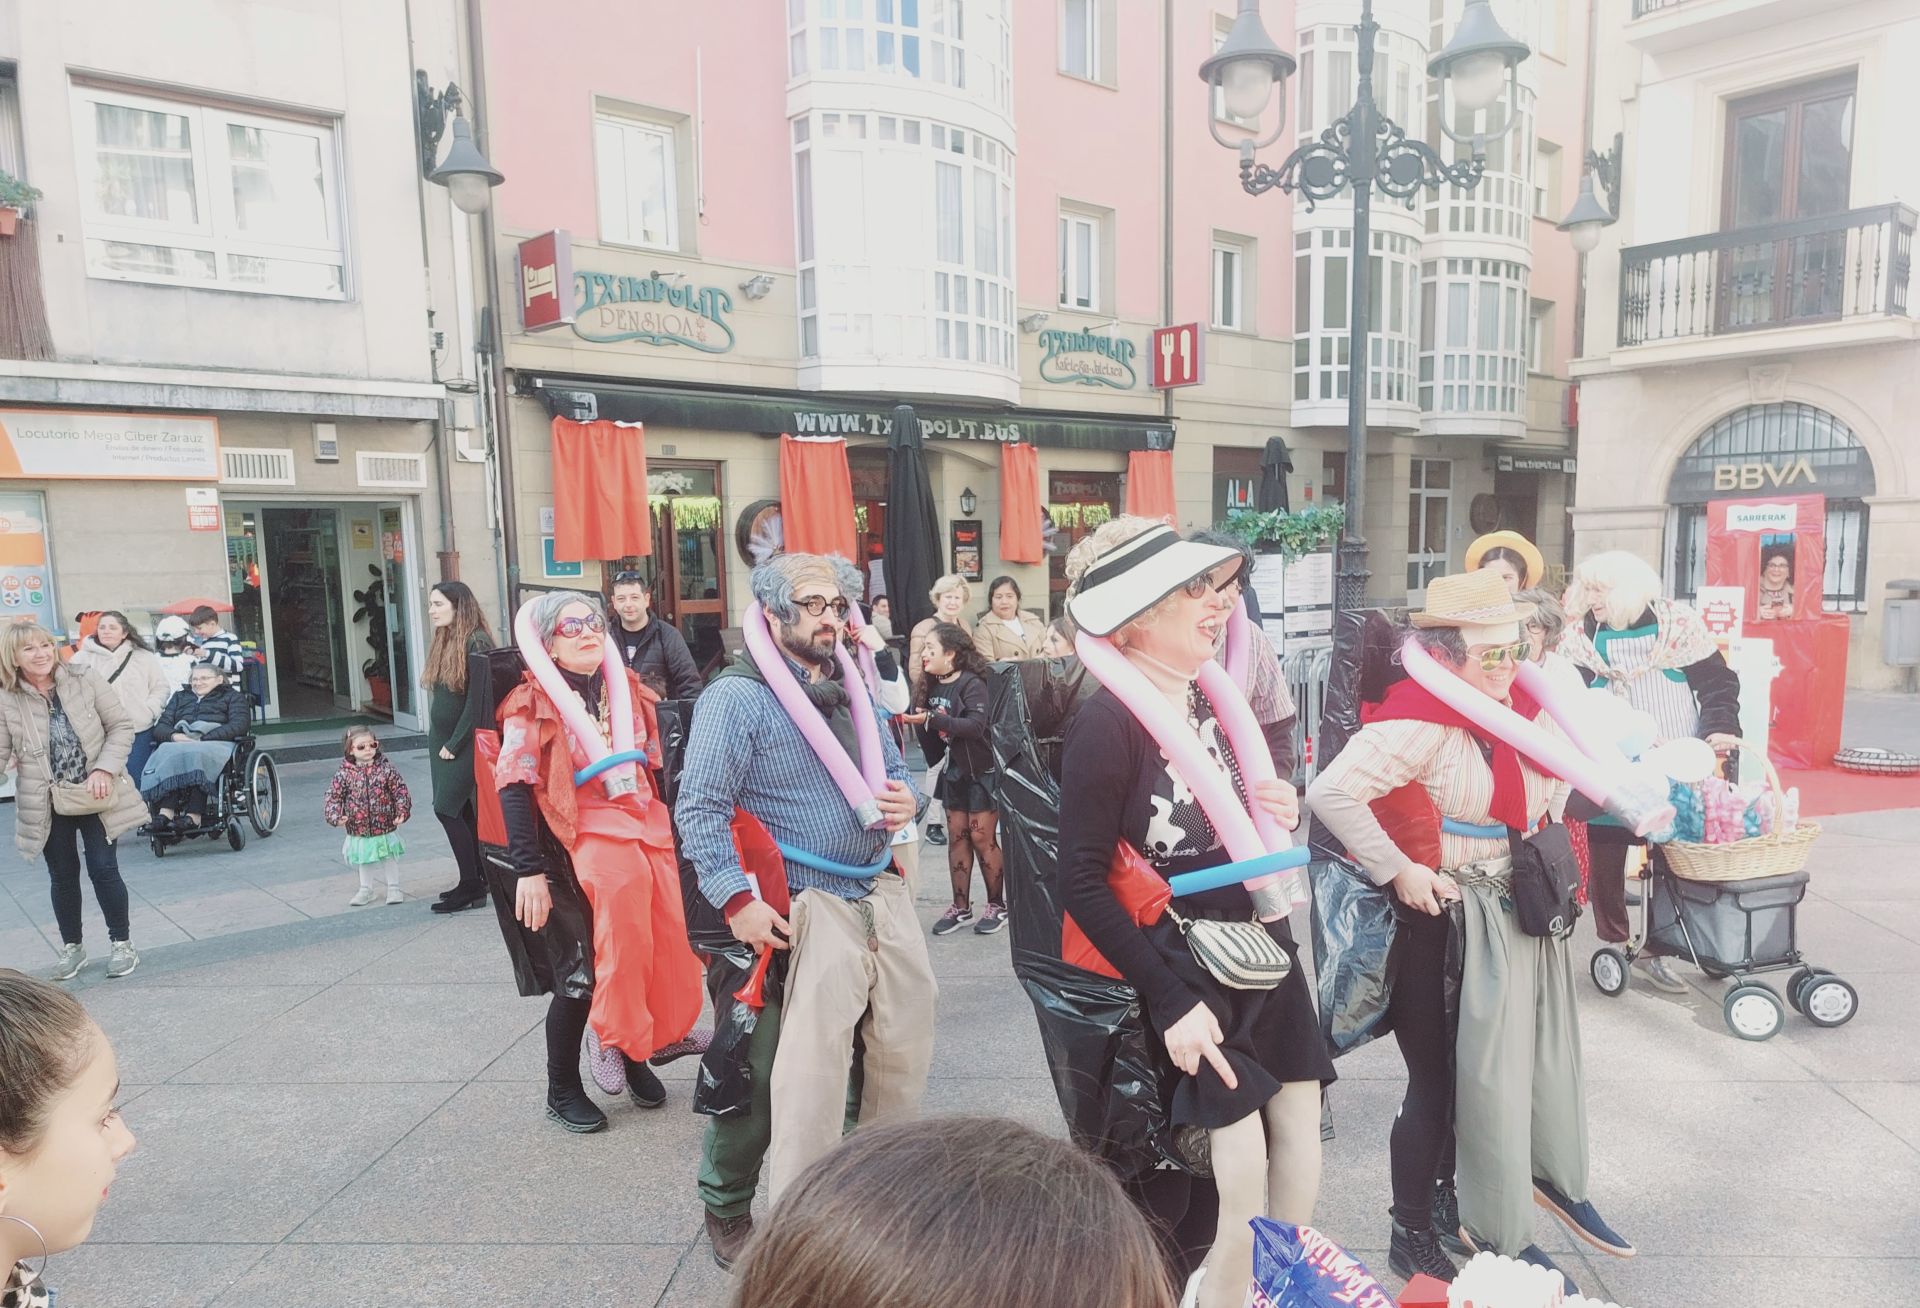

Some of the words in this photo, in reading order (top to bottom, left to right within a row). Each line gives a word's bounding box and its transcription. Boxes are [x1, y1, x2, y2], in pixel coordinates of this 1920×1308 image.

[16, 428, 80, 441] Locutorio
[83, 429, 121, 443] Mega
[124, 430, 158, 443] Ciber
[161, 431, 204, 443] Zarauz
[1713, 457, 1817, 491] BBVA
[1736, 513, 1787, 523] SARRERAK
